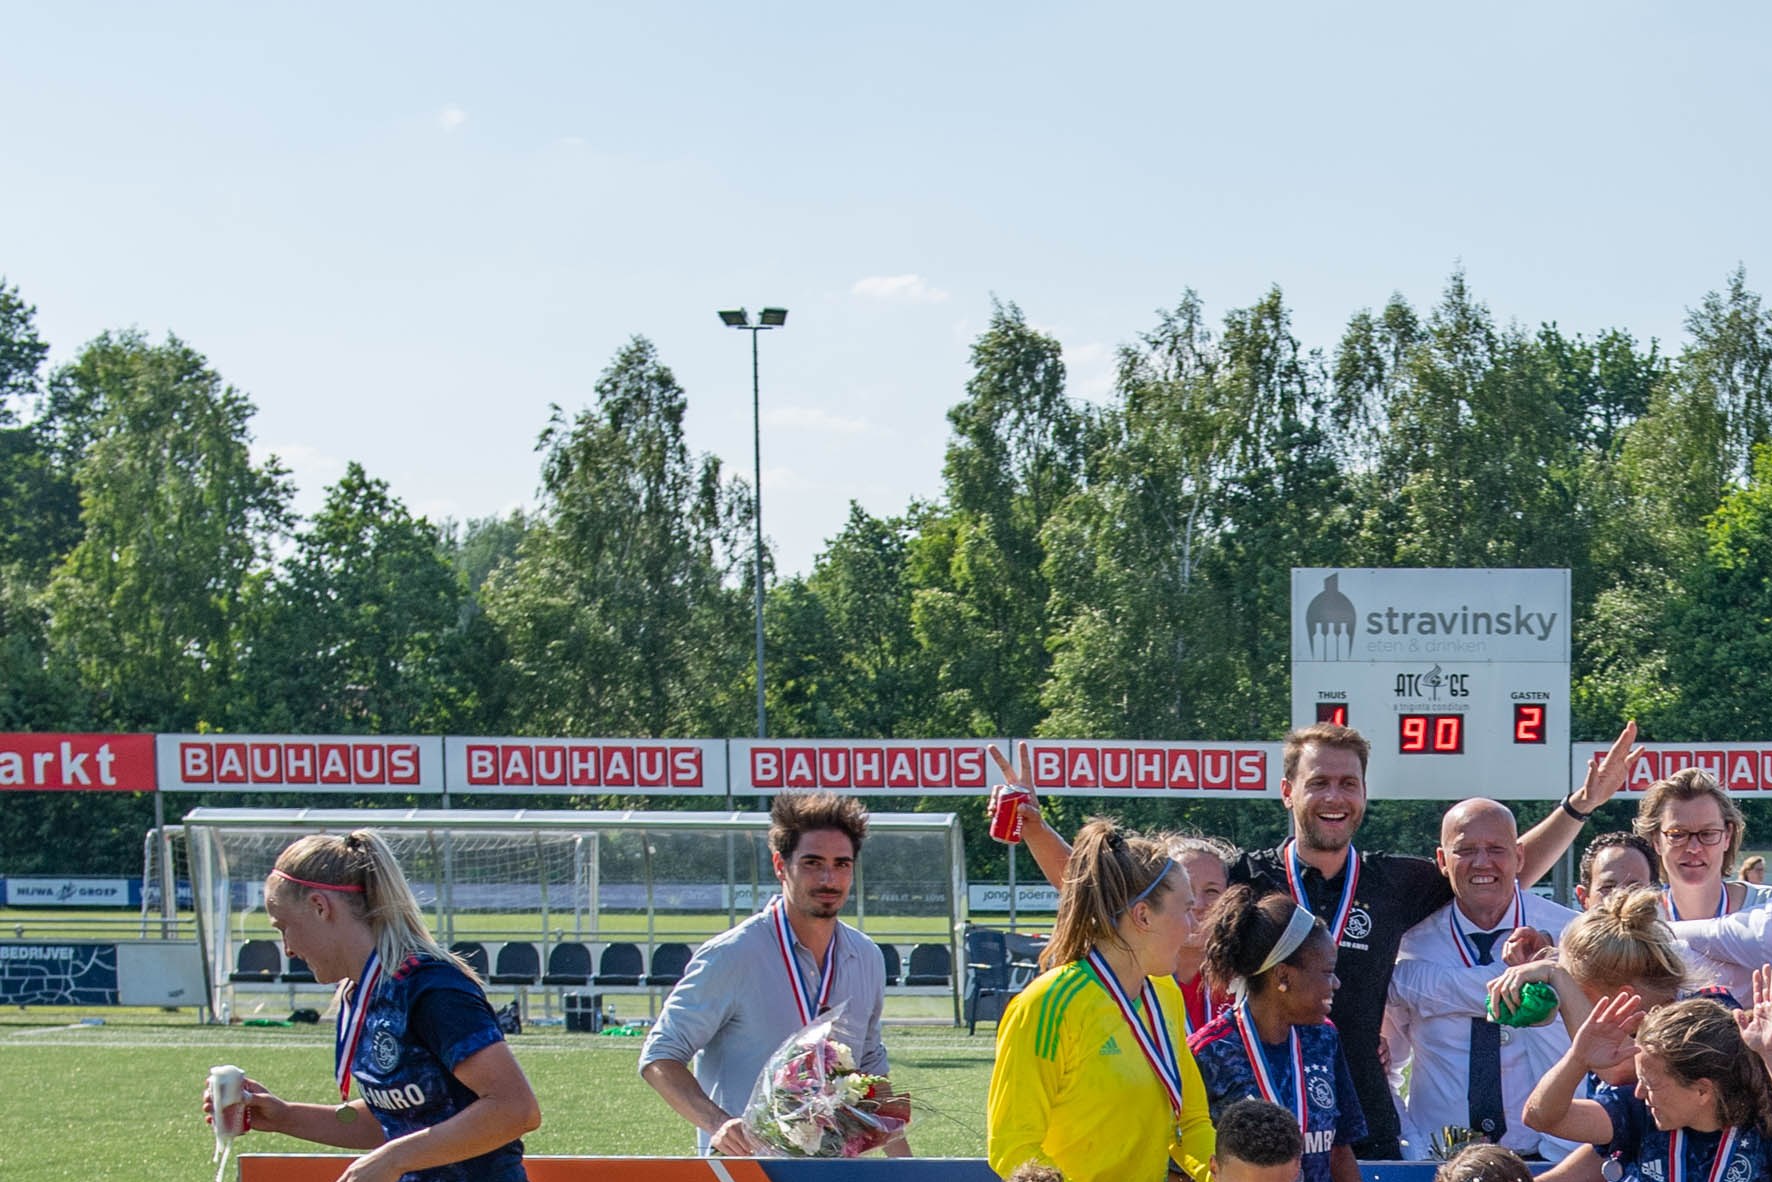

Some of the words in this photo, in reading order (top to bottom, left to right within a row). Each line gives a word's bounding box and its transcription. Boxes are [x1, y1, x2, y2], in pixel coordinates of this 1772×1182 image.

[1366, 605, 1558, 641] stravinsky
[1425, 638, 1487, 653] drinken
[1318, 690, 1347, 700] THUIS
[1511, 691, 1550, 701] GASTEN
[1402, 717, 1459, 751] 90
[1516, 706, 1543, 741] 2
[182, 744, 418, 782] BAUHAUS
[469, 747, 701, 784] BAUHAUS
[752, 749, 985, 786] BAUHAUS
[1037, 749, 1265, 787] BAUHAUS
[78, 886, 118, 898] GROEP
